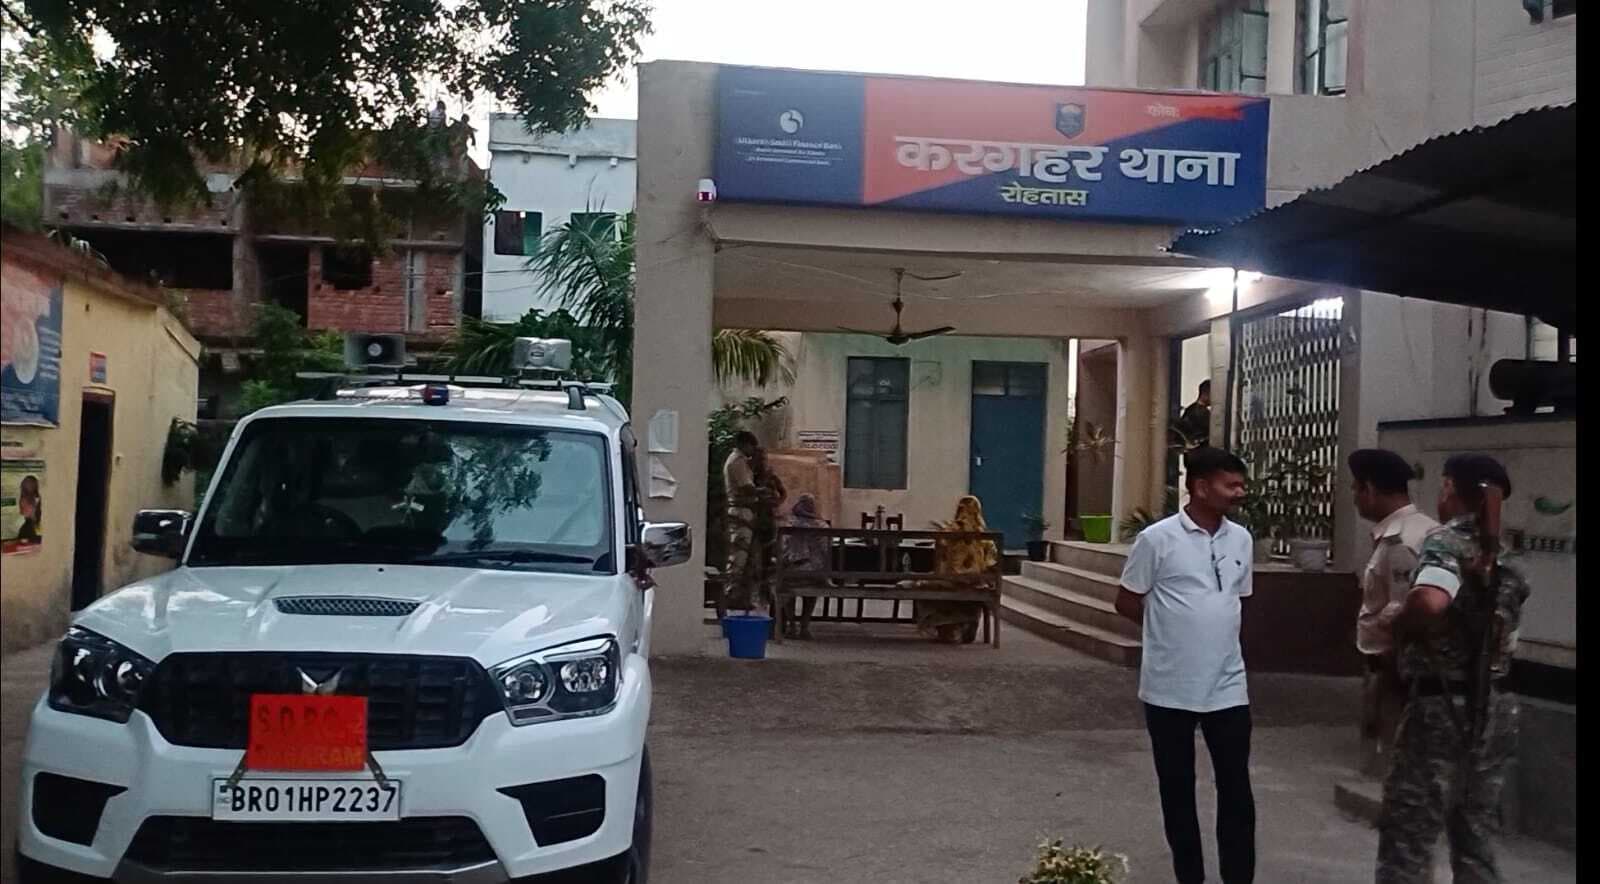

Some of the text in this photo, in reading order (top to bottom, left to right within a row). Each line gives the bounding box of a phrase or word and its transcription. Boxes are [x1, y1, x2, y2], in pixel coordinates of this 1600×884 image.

[895, 136, 1242, 187] करगहर थाना
[1000, 181, 1089, 206] रोहतास
[232, 786, 397, 812] BR01HP2237
